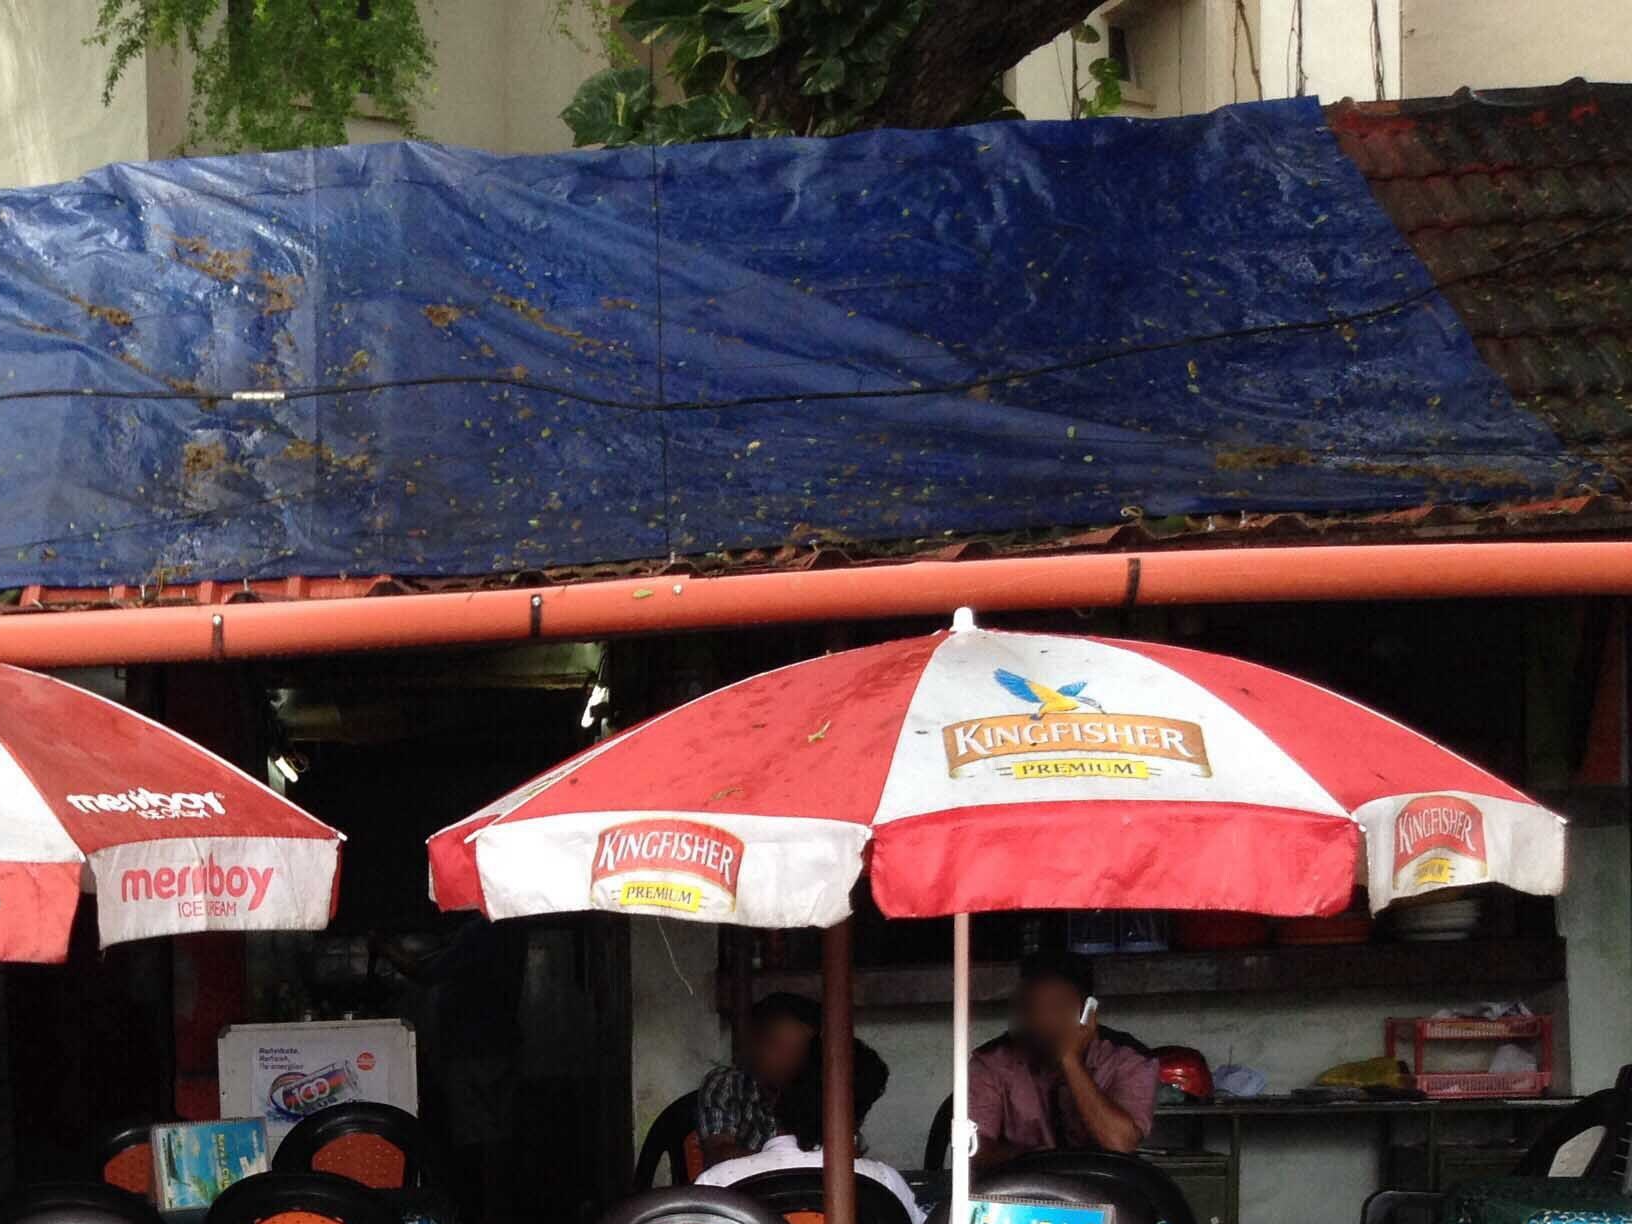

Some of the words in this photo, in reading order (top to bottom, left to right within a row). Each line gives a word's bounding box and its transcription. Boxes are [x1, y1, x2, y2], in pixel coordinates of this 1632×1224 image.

[954, 722, 1194, 757] KINGFISHER
[1023, 762, 1133, 775] PREMIUM
[1399, 807, 1476, 855] KINGFISHER
[597, 829, 734, 885] KINGFISHER
[625, 886, 693, 905] PREMIUM
